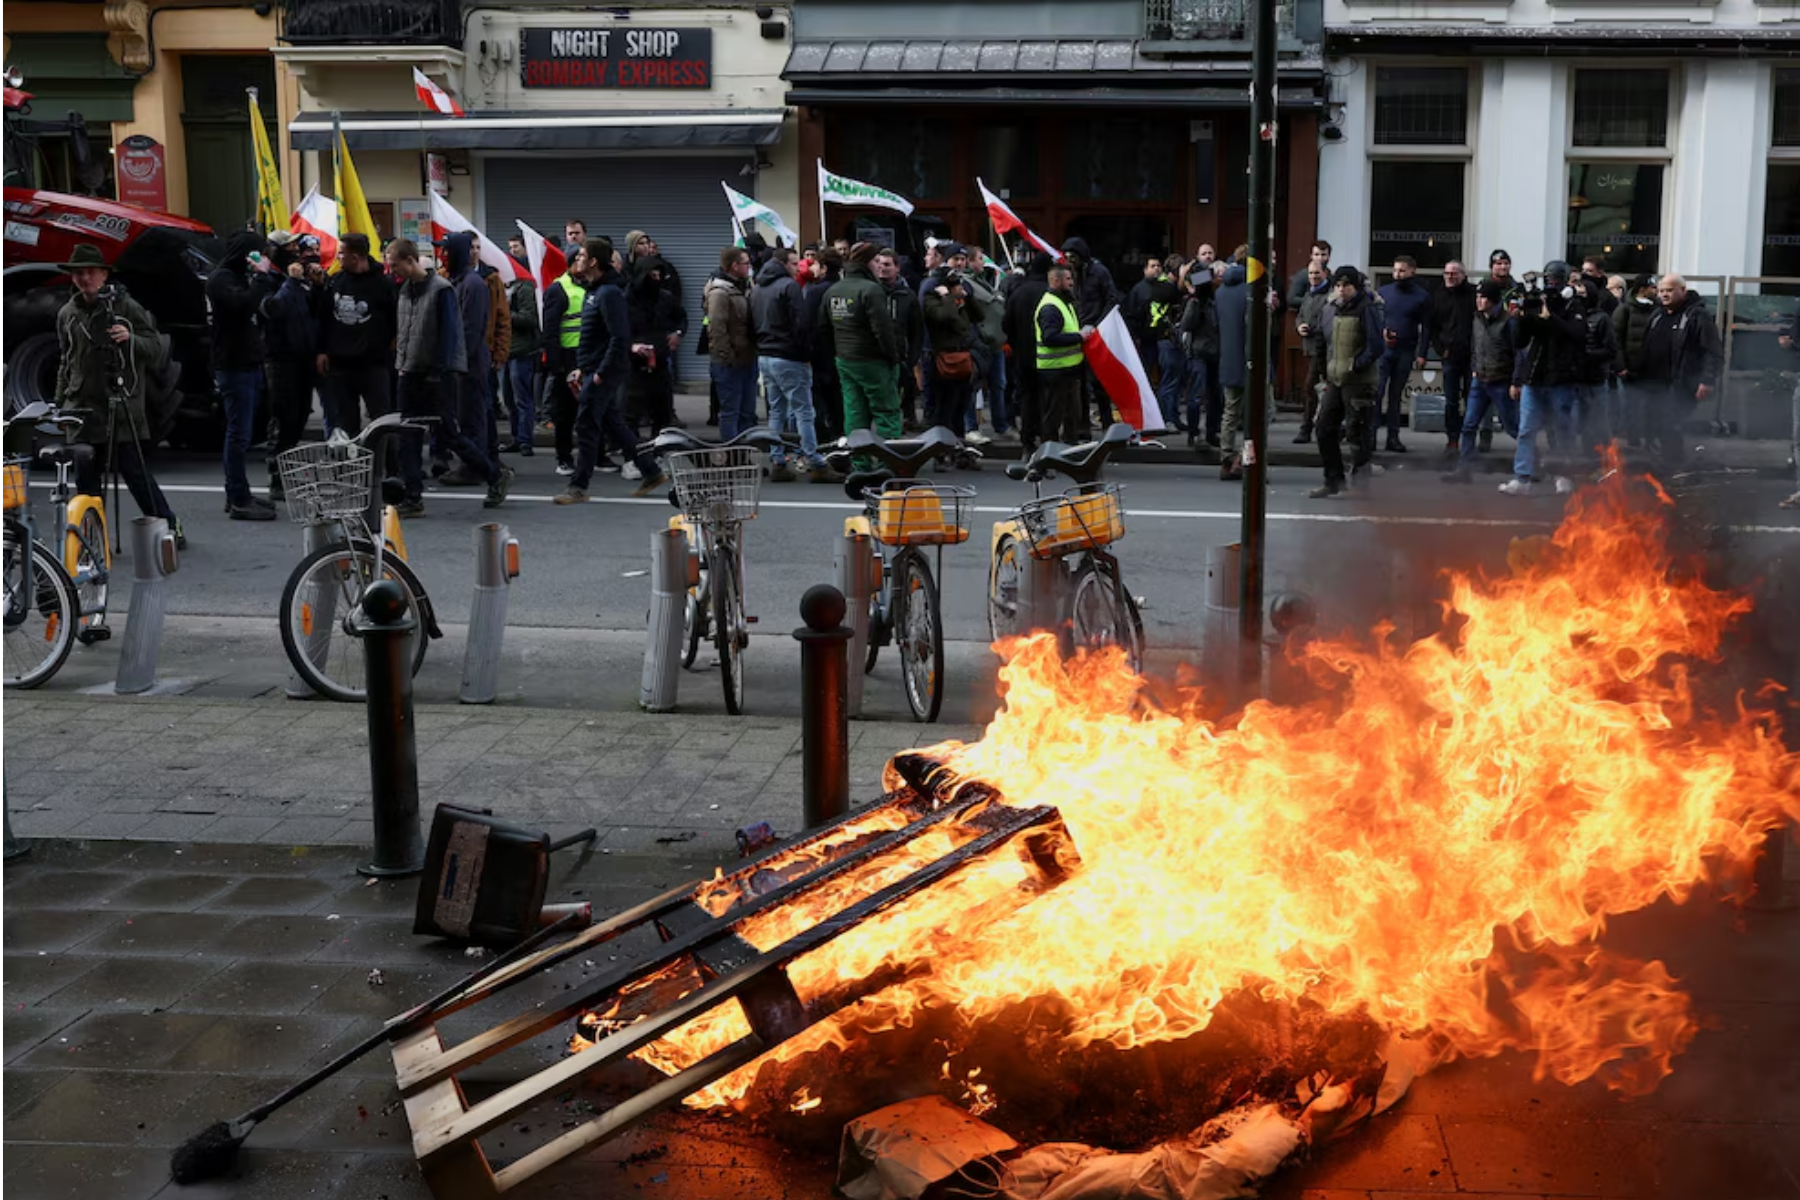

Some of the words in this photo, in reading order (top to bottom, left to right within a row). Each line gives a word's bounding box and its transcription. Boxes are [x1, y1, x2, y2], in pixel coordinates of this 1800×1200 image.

[551, 30, 610, 57] NIGHT
[626, 30, 679, 57] SHOP
[527, 60, 609, 86] BOMBAY
[618, 60, 707, 86] EXPRESS
[96, 214, 130, 232] 200
